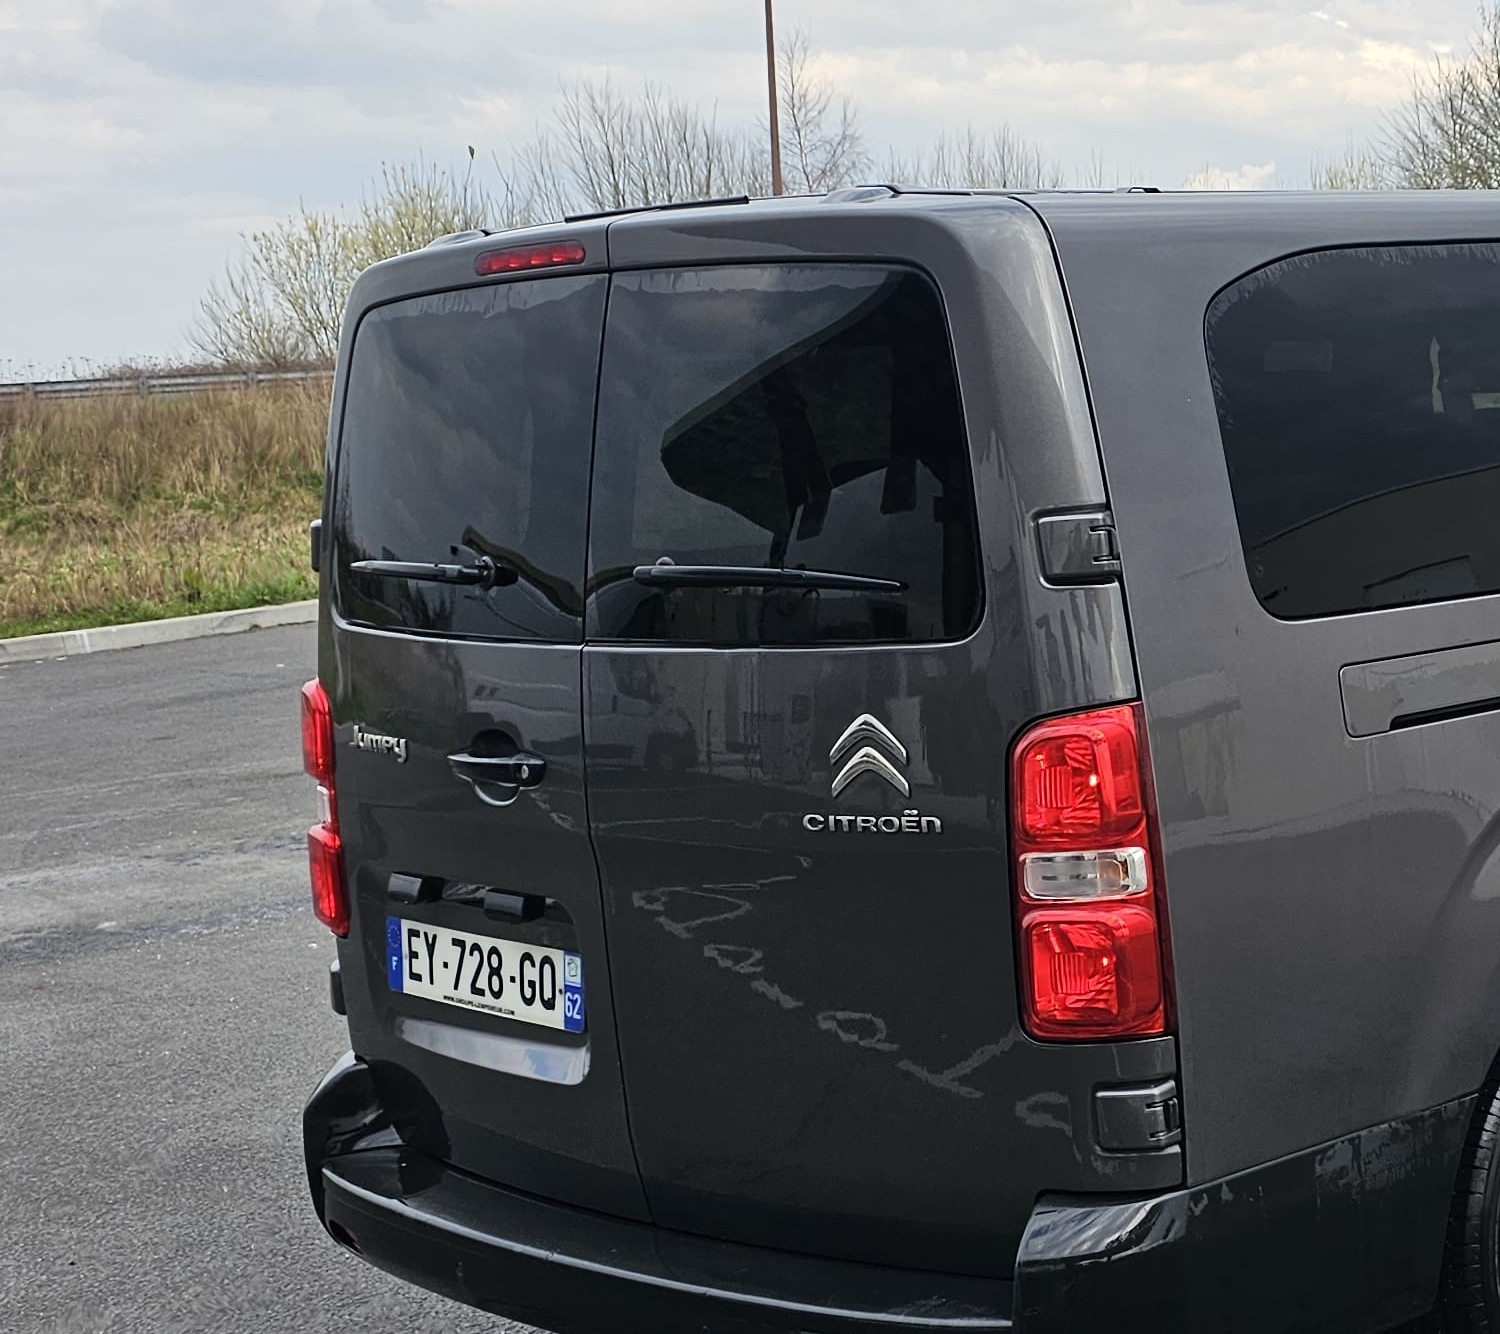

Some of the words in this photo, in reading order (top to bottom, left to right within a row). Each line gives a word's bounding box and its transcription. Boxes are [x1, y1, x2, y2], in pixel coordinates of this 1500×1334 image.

[349, 724, 407, 763] Jumpy
[391, 955, 399, 971] F
[407, 927, 557, 1012] EY-728-GQ
[565, 991, 581, 1020] 62
